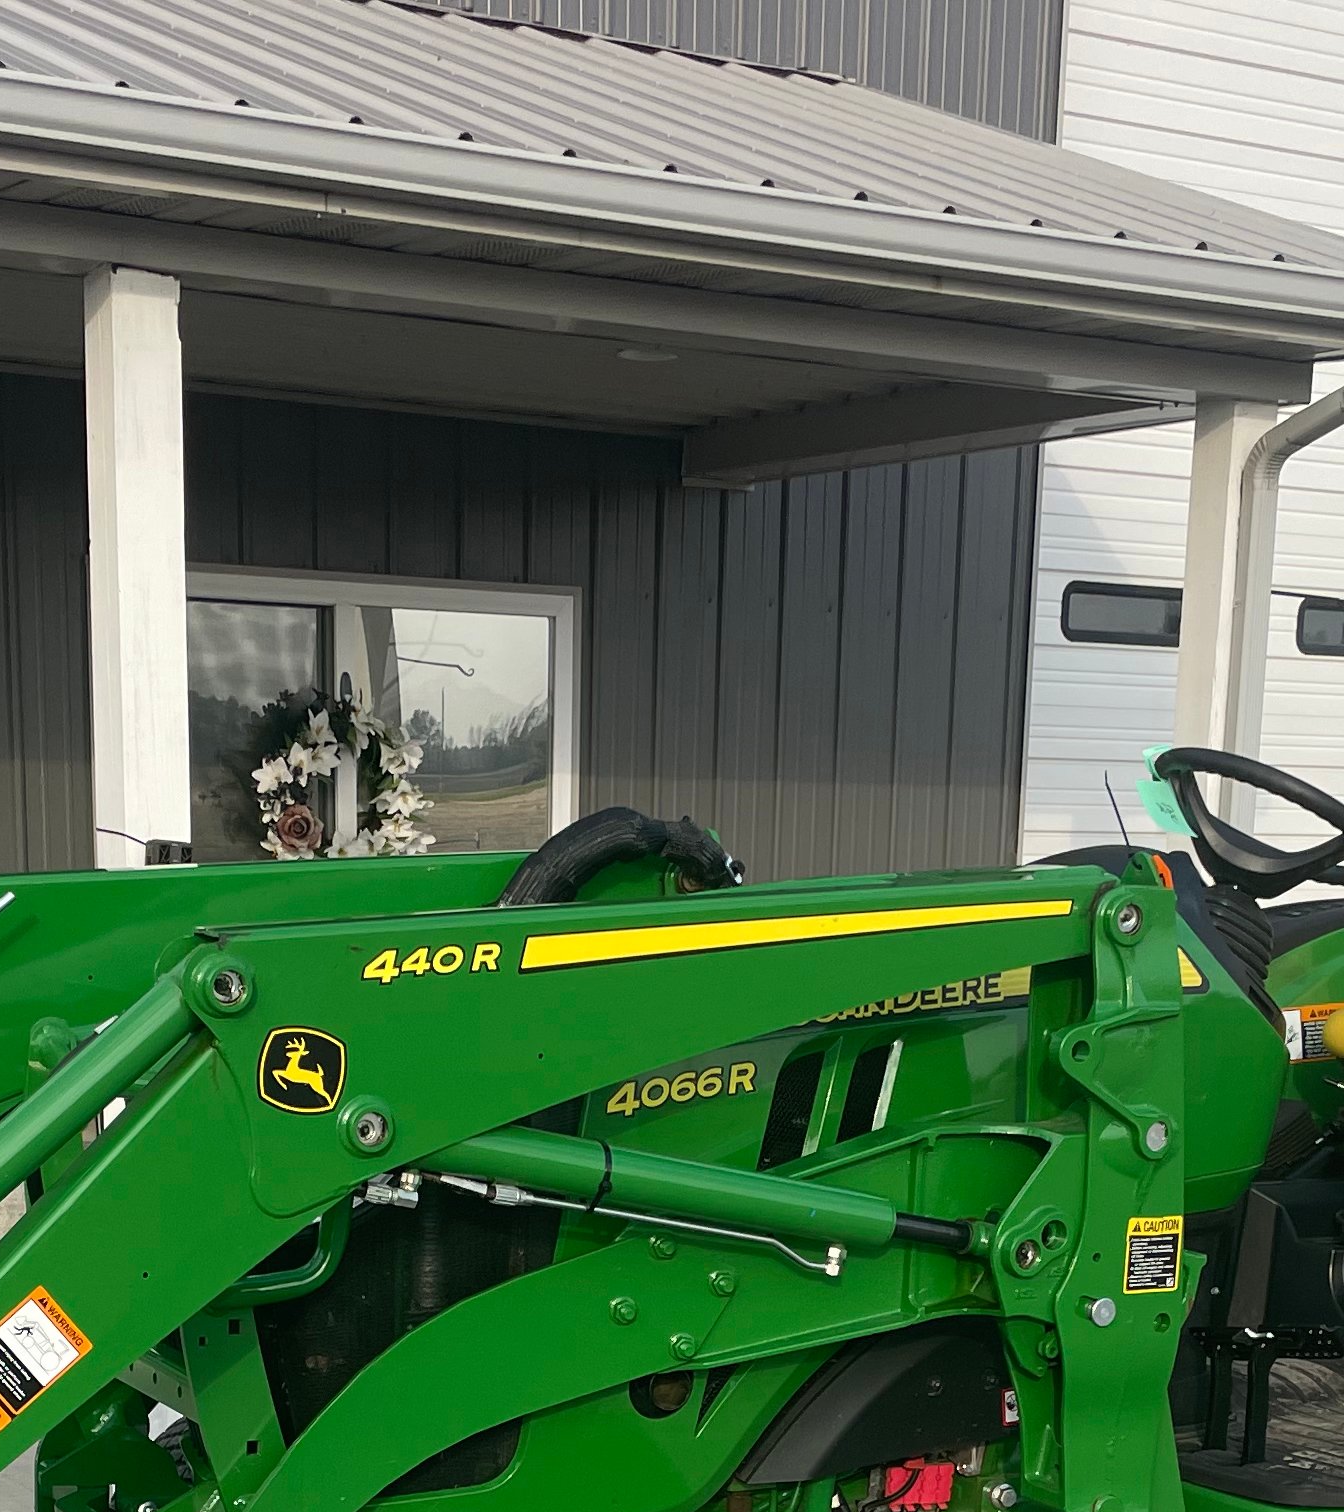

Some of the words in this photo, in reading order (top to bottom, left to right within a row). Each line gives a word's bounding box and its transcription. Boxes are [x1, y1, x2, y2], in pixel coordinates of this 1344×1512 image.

[893, 972, 1004, 1015] DEERE
[605, 1061, 757, 1117] 4066R
[1143, 1218, 1180, 1233] CAUTION
[47, 1305, 84, 1347] WARNING
